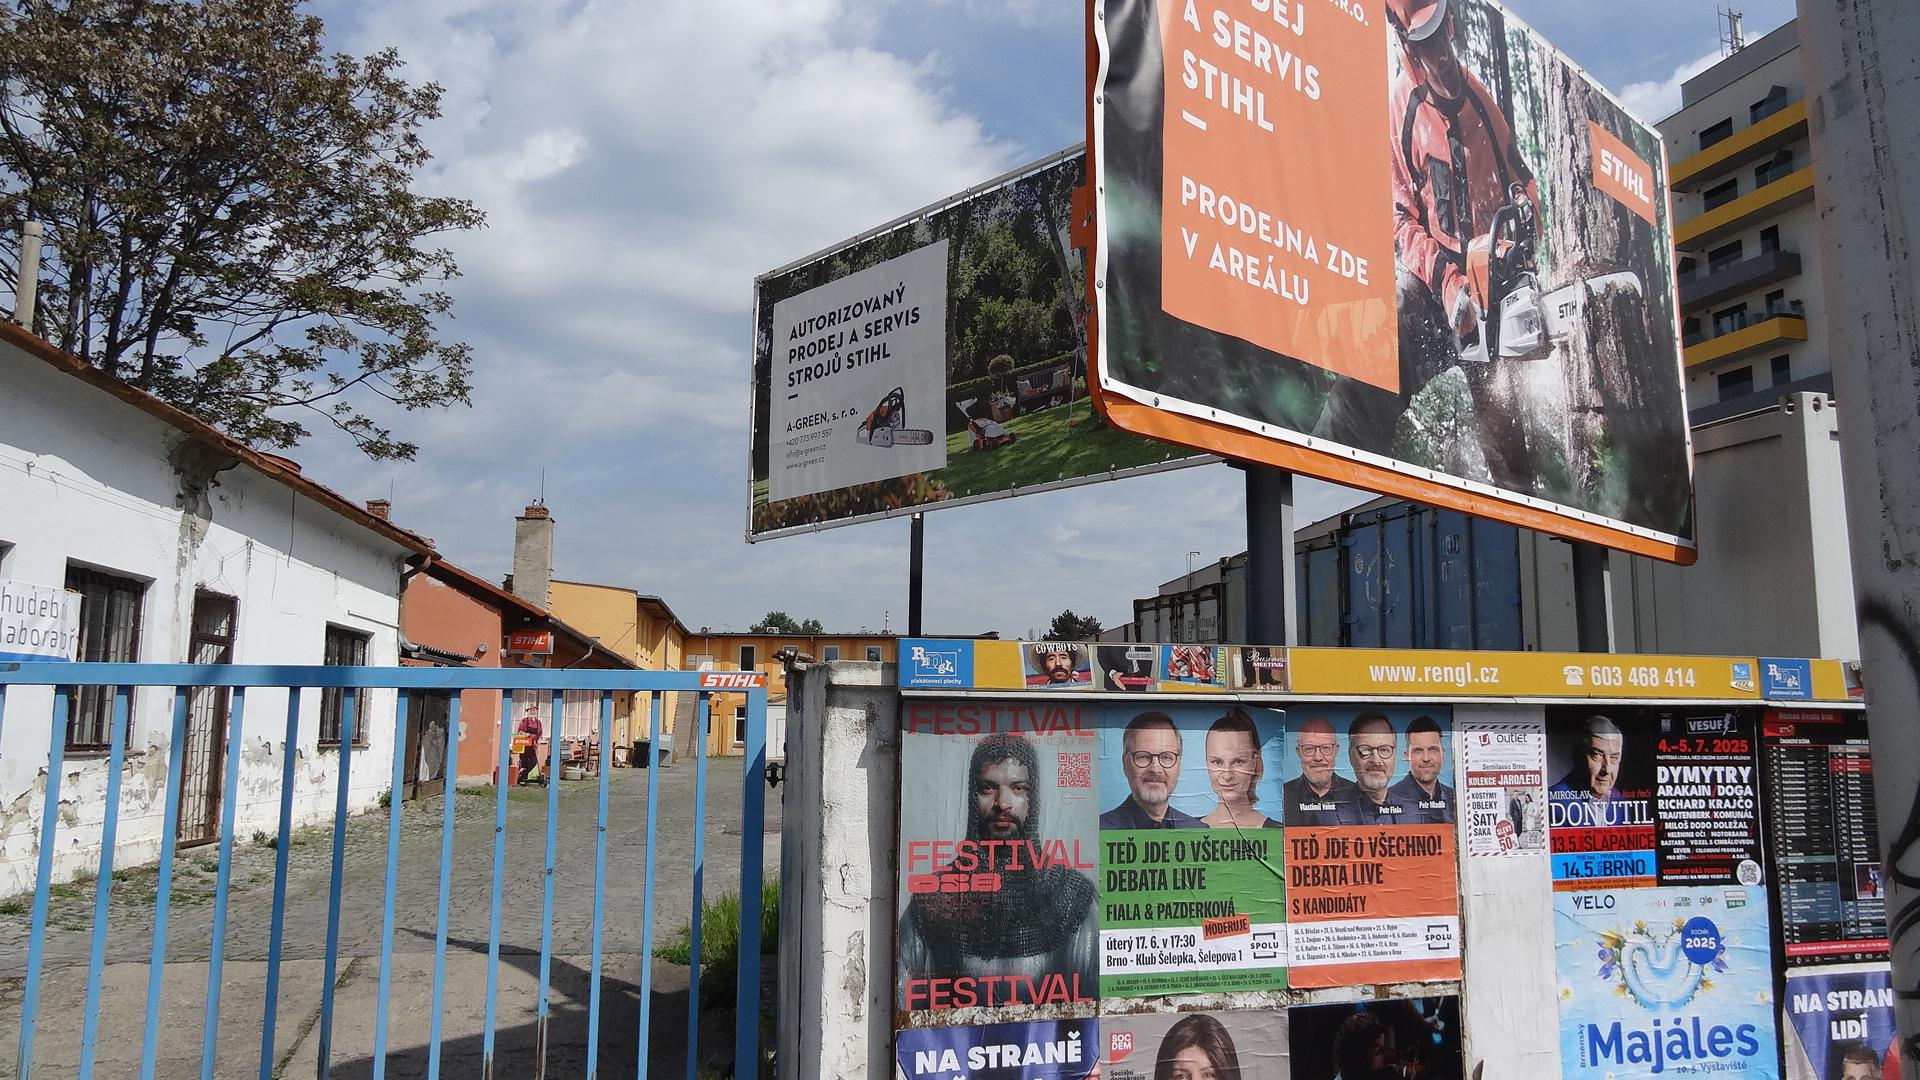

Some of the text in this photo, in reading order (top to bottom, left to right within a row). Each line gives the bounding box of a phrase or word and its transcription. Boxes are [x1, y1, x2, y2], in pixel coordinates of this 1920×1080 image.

[1183, 0, 1320, 100] A SERVIS
[1182, 49, 1274, 133] STIHL
[1600, 148, 1650, 205] STIHL
[1182, 175, 1369, 286] PRODEJNA ZDE
[1182, 227, 1309, 305] V AREÁLU
[789, 282, 905, 341] AUTORIZOVANÝ
[1559, 300, 1577, 319] STIH
[788, 307, 920, 364] PRODEJ A SERVIS
[787, 342, 891, 387] STROJŮ STIHL
[787, 411, 829, 433] A-GREEN,
[514, 637, 544, 645] STIHL
[1035, 643, 1078, 654] COWBOYS
[1216, 648, 1225, 683] SUMME
[1247, 651, 1288, 662] Business
[703, 674, 761, 687] STIHL
[1369, 662, 1500, 687] www.rengl.cz
[1591, 665, 1696, 688] 603 468 414
[908, 704, 1095, 737] FESTIVAL
[1497, 733, 1527, 743] outlet
[1696, 739, 1709, 752] 7.
[1713, 739, 1749, 752] 2025
[1469, 773, 1540, 785] KOLEKCE JARO/LÉTO
[1657, 766, 1752, 783] DYMYTRY
[1472, 791, 1497, 799] KOSTÝMY
[1549, 791, 1590, 800] MIROSLAV
[1657, 785, 1753, 797] ARAKAIN DOGA
[1472, 801, 1497, 810] OBLEKY
[1658, 797, 1753, 809] RICHARD KRAJČO
[1473, 811, 1498, 826] ŠATY
[1550, 801, 1654, 826] DONUTIL
[1714, 809, 1753, 819] KOMUNÁL
[1474, 828, 1491, 837] SAKA
[1665, 820, 1689, 829] MILOŠ
[1714, 820, 1748, 829] DOLEŽAL
[1106, 836, 1269, 865] TEĎ JDE O VŠECHNO!
[1291, 831, 1442, 860] TEĎ JDE O VŠECHNO!
[1552, 831, 1655, 853] 13.5. ŠLAPANICE
[907, 839, 1094, 872] FESTIVAL
[1292, 863, 1383, 888] DEBATA LIVE
[1563, 859, 1645, 878] 14.5. BRNO
[1106, 867, 1206, 893] DEBATA LIVE
[1106, 897, 1236, 922] FIALA & PAZDERKOVÁ
[1292, 893, 1366, 915] S KANDIDÁTY
[1572, 895, 1615, 909] VELO
[1205, 918, 1248, 936] MODERUJE
[1106, 935, 1196, 954] úterý 17. 6. v 17:30
[1686, 937, 1717, 949] 2025
[1106, 949, 1243, 967] Brno Klub Šelepka, Šelepova 1
[906, 973, 1094, 1009] FESTIVAL
[1793, 988, 1893, 1014] NA STRAN
[1831, 1013, 1868, 1040] LIDÍ
[1112, 1034, 1131, 1042] SOC
[1112, 1042, 1131, 1050] DEM
[1588, 1016, 1759, 1074] Majáles
[915, 1030, 1082, 1075] NA STRANĚ
[1110, 1069, 1134, 1077] Sociální
[1700, 1061, 1747, 1074] Výstaviště
